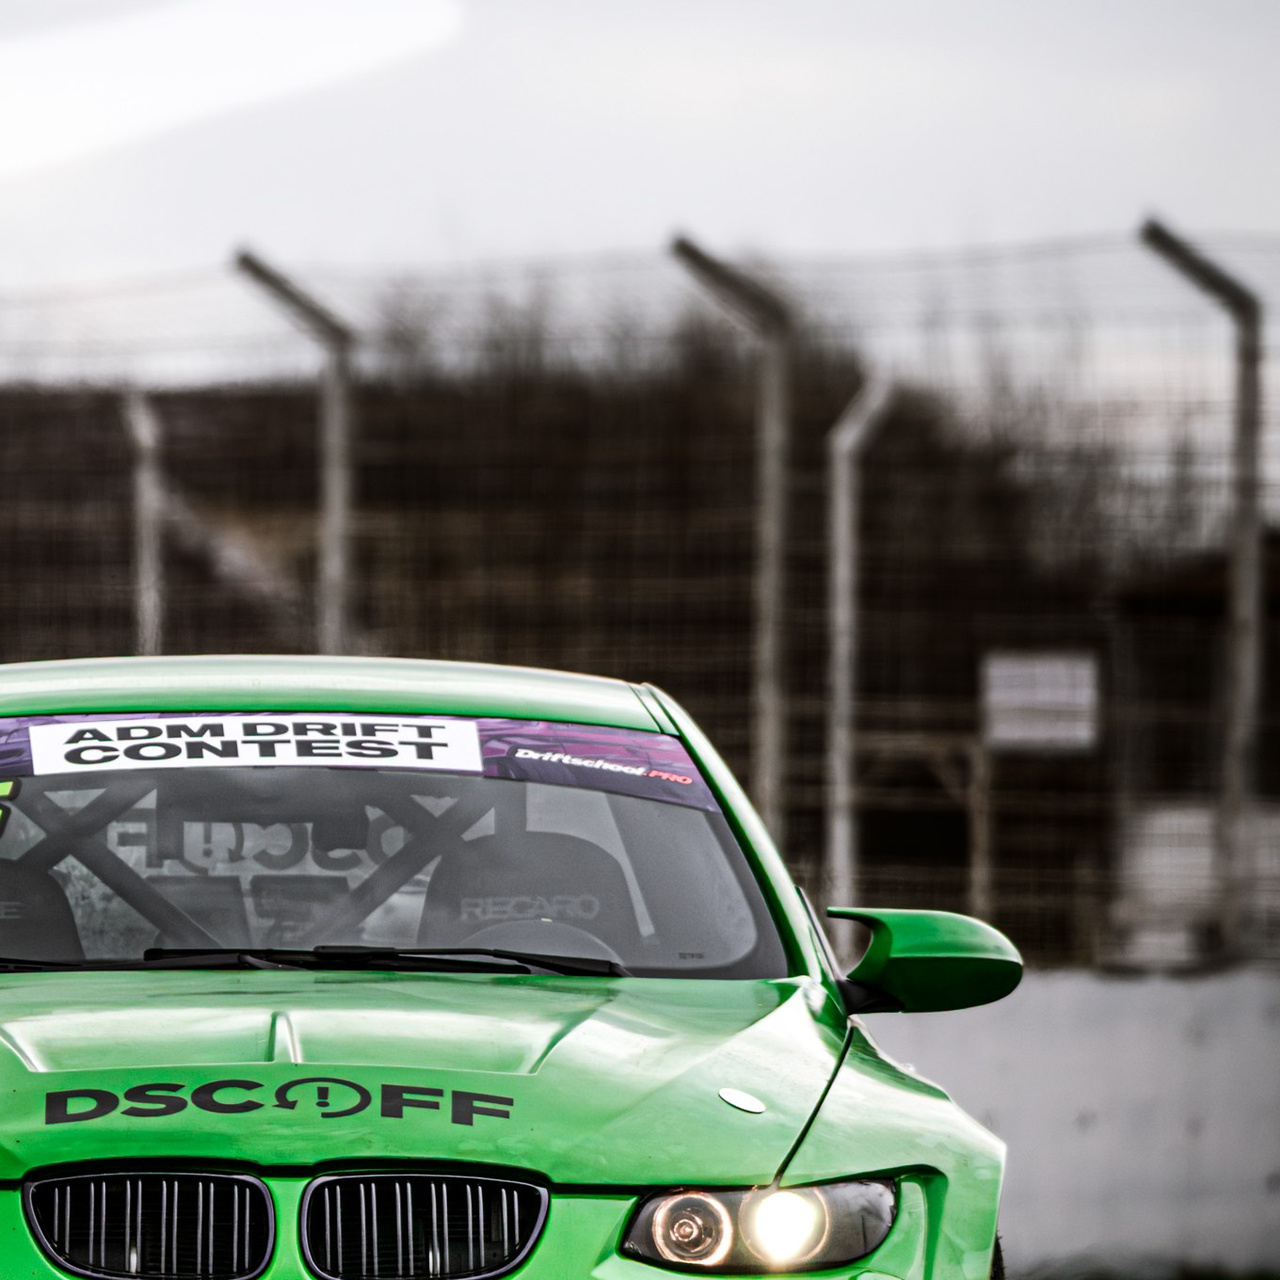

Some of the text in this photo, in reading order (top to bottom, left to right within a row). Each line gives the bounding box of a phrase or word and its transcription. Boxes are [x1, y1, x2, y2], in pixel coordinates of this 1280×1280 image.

[63, 721, 446, 744] ADM DRIFT
[63, 739, 448, 765] CONTEST
[460, 894, 600, 921] RECARO
